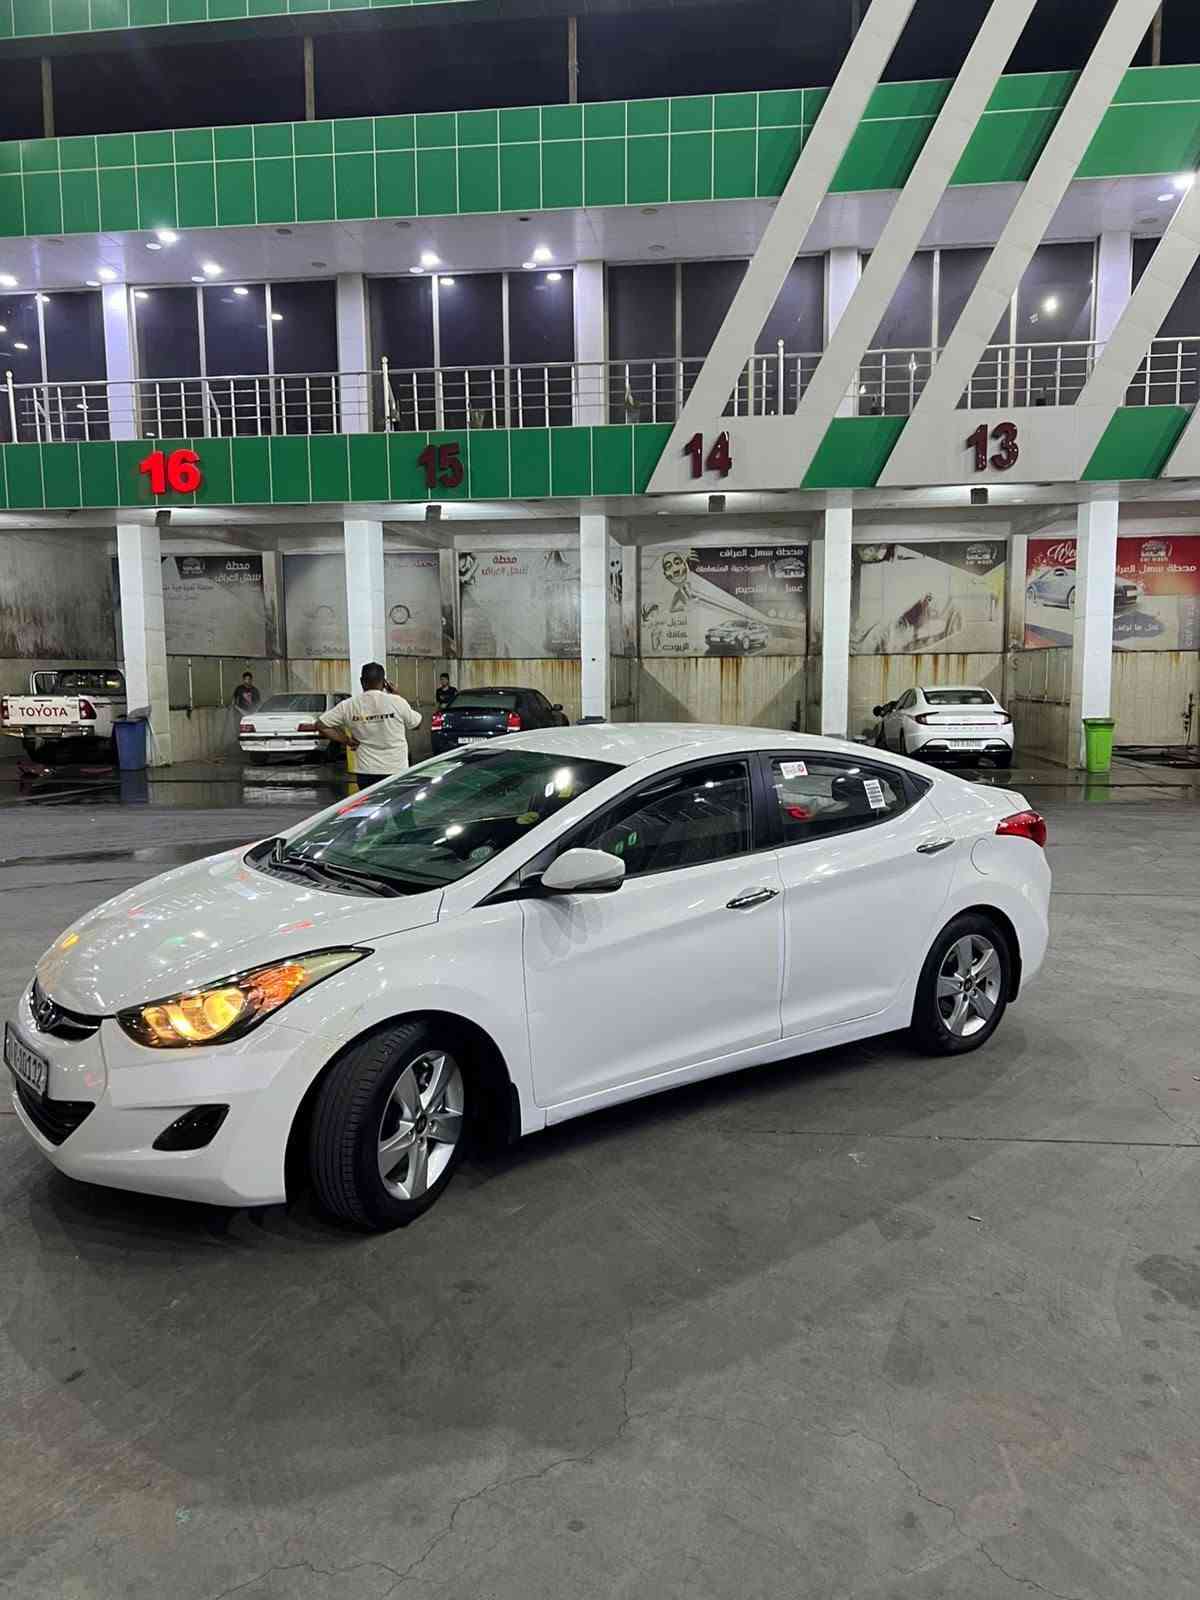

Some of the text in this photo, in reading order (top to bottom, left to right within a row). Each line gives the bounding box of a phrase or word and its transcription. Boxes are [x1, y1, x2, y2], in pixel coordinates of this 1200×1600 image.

[417, 442, 465, 489] 15
[683, 431, 734, 479] 14
[965, 422, 1019, 472] 13
[138, 448, 202, 495] 16
[19, 707, 68, 717] TOYOTA
